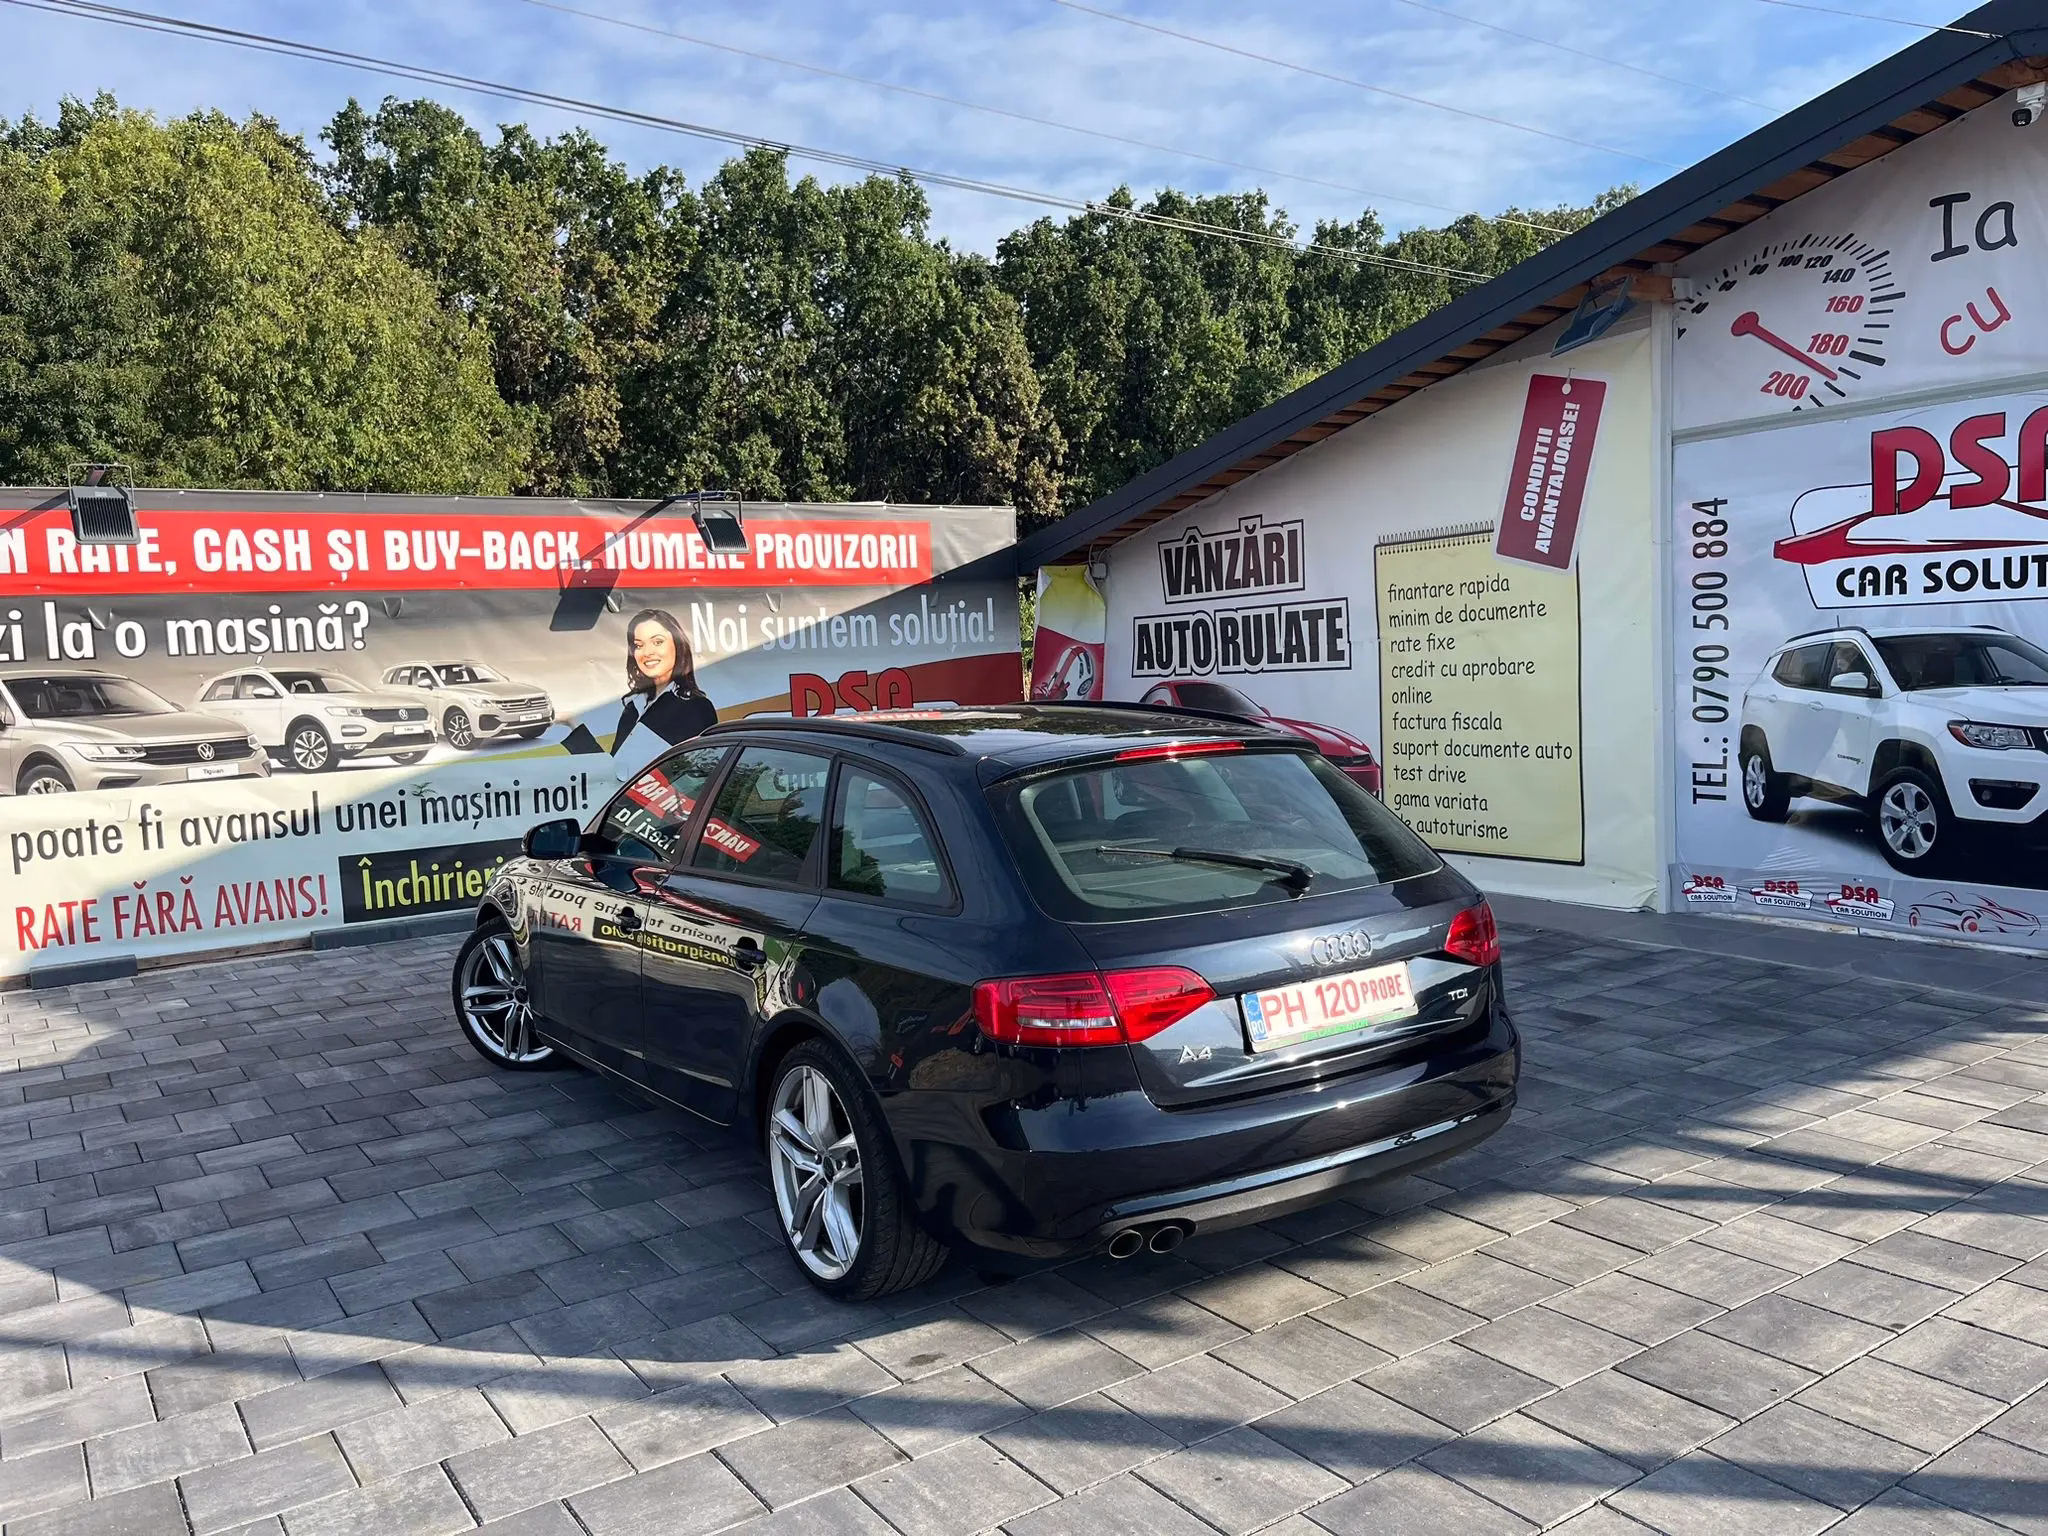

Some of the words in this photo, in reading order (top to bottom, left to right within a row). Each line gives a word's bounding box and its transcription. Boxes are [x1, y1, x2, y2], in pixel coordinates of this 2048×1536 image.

[1929, 192, 2018, 262] Ia
[1778, 254, 1803, 267] 100
[1804, 255, 1834, 269] 120
[1822, 268, 1856, 284] 140
[1825, 295, 1864, 313] 160
[1940, 287, 2011, 355] cu
[1807, 334, 1849, 356] 180
[1760, 371, 1810, 400] 200
[1520, 427, 1553, 522] CONDITII
[1534, 402, 1581, 554] AVANTAJOASE!
[1692, 497, 1728, 560] 884
[193, 528, 312, 572] CASH
[327, 529, 370, 582] ȘI
[755, 533, 918, 570] PROVIZORII
[1163, 523, 1299, 597] VÂNZĂRI
[1388, 582, 1455, 602] finantare
[1459, 573, 1510, 599] rapida
[1836, 564, 1908, 598] CAR
[1389, 609, 1430, 628] minim
[1435, 606, 1454, 624] de
[1458, 600, 1547, 623] documente
[1692, 571, 1729, 631] 500
[43, 600, 96, 661] la
[115, 620, 147, 658] o
[166, 601, 370, 665] mașină?
[691, 602, 748, 654] Noi
[760, 607, 878, 650] suntem
[889, 594, 996, 653] soluția!
[1136, 618, 1212, 671] AUTO
[1219, 607, 1345, 667] RULATE
[1390, 636, 1422, 653] rate
[1427, 633, 1456, 652] fixe
[1391, 660, 1435, 679] credit
[1441, 663, 1457, 677] cu
[1462, 657, 1536, 682] aprobare
[1692, 644, 1729, 723] 0790
[1392, 686, 1433, 704] online
[1392, 712, 1447, 731] factura
[1452, 711, 1502, 731] fiscala
[1392, 740, 1439, 760] suport
[1444, 738, 1530, 758] documente
[1535, 742, 1572, 760] auto
[1393, 764, 1423, 781] test
[1428, 764, 1467, 783] drive
[1692, 736, 1729, 805] TEL.:
[1394, 792, 1430, 811] gama
[1434, 792, 1488, 811] variata
[10, 819, 123, 875] poate
[138, 803, 164, 850] fi
[180, 790, 321, 848] avansul
[335, 789, 407, 832] unei
[420, 779, 521, 831] mașini
[534, 772, 589, 814] noi!
[1416, 818, 1509, 839] autoturisme
[358, 857, 504, 910] Închirier
[1692, 875, 1725, 889] DSA
[1764, 880, 1800, 894] DSA
[1841, 885, 1879, 903] DSA
[15, 898, 101, 951] RATE
[113, 874, 202, 940] FĂRĂ
[213, 874, 329, 928] AVANS!
[1774, 899, 1806, 908] SOLUTION
[1850, 908, 1887, 918] SOLUTION
[1260, 989, 1308, 1032] PH
[1315, 979, 1361, 1019] 120
[1360, 974, 1404, 1004] PROBE
[1448, 987, 1468, 1000] TDI
[1178, 1045, 1212, 1065] A4
